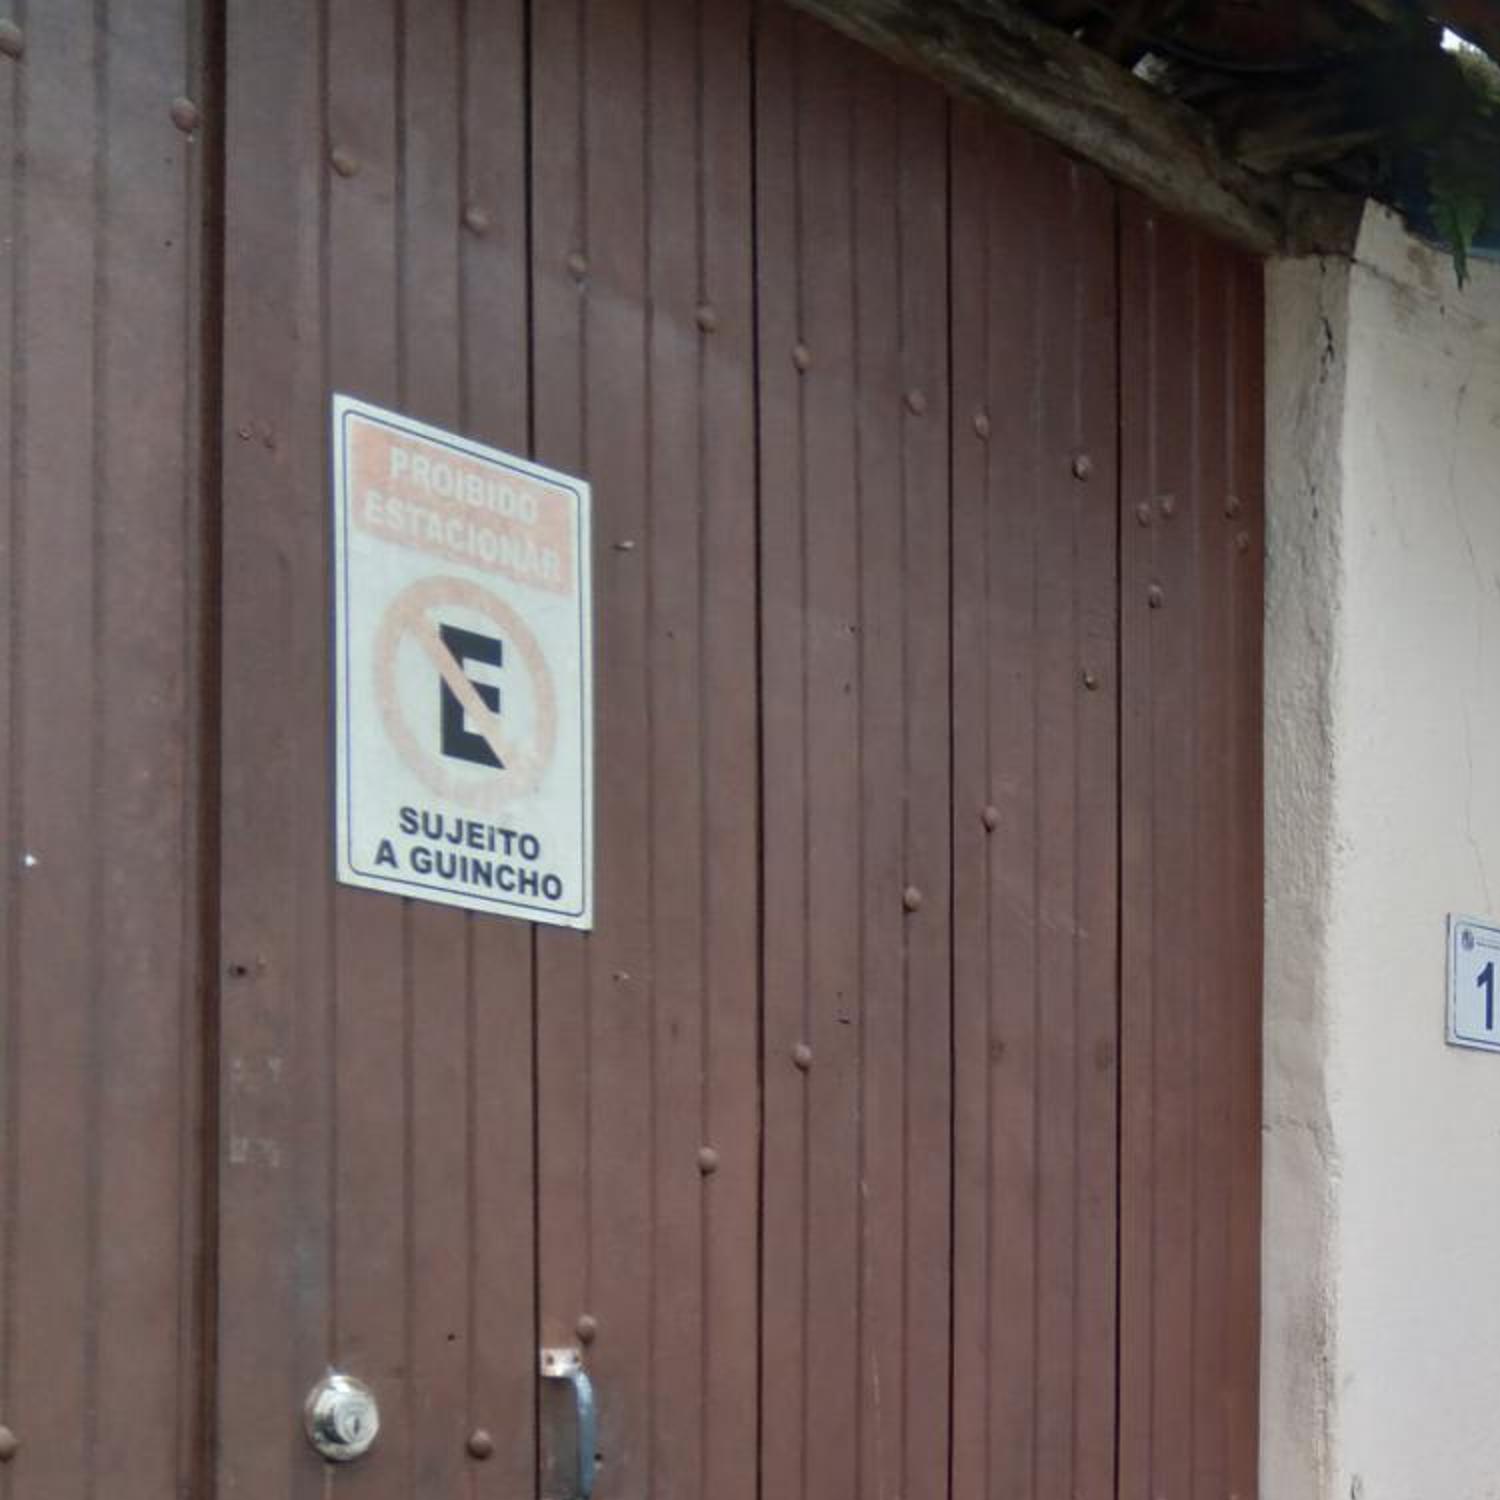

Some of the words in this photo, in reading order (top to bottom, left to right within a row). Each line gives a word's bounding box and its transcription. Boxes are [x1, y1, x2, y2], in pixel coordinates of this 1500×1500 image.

[390, 447, 538, 527] PROIBIDO
[365, 491, 560, 579] ESTACIONAR
[399, 806, 541, 862] SUJEITO
[374, 839, 399, 869] A
[409, 845, 564, 901] GUINCHO
